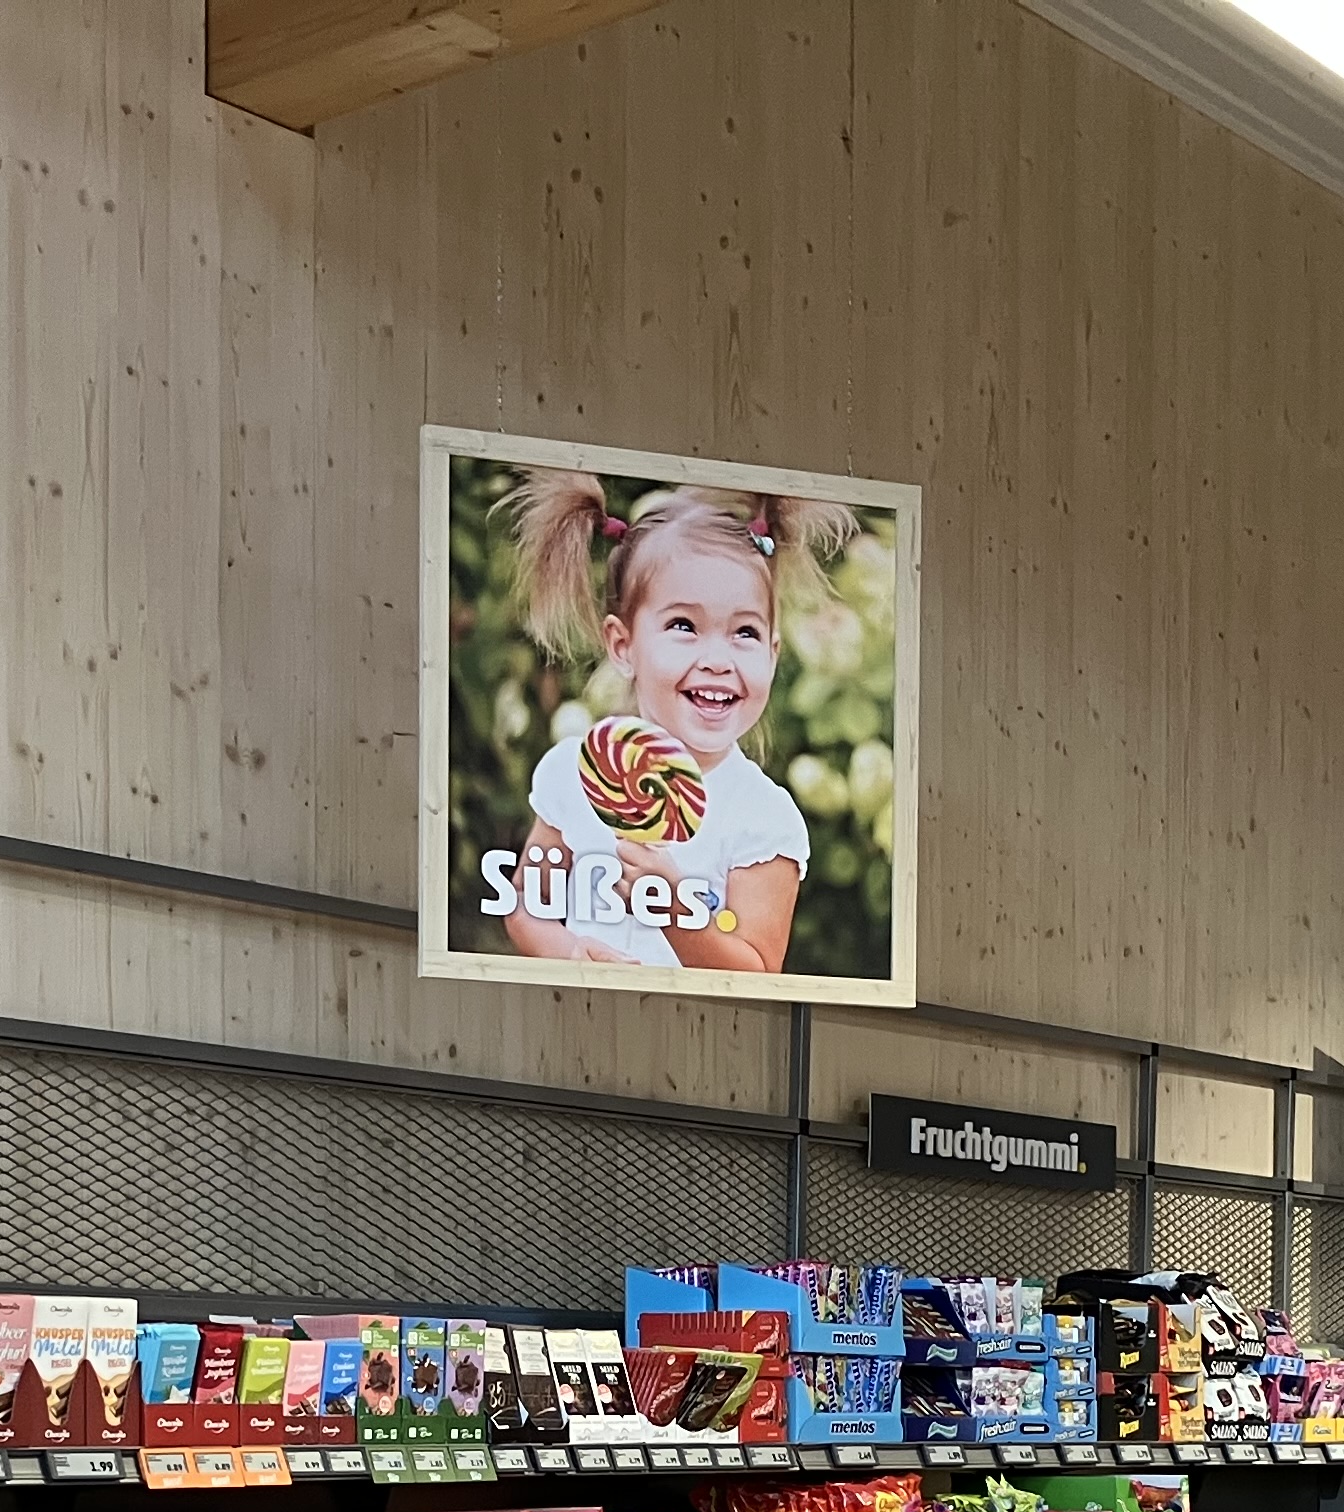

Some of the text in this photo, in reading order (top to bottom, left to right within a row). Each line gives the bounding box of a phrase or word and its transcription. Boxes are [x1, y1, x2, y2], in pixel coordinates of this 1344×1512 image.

[480, 846, 738, 933] Süßes.
[910, 1117, 1087, 1173] Fruchtgummi.
[832, 1332, 877, 1346] mentos
[830, 1420, 875, 1434] mentos
